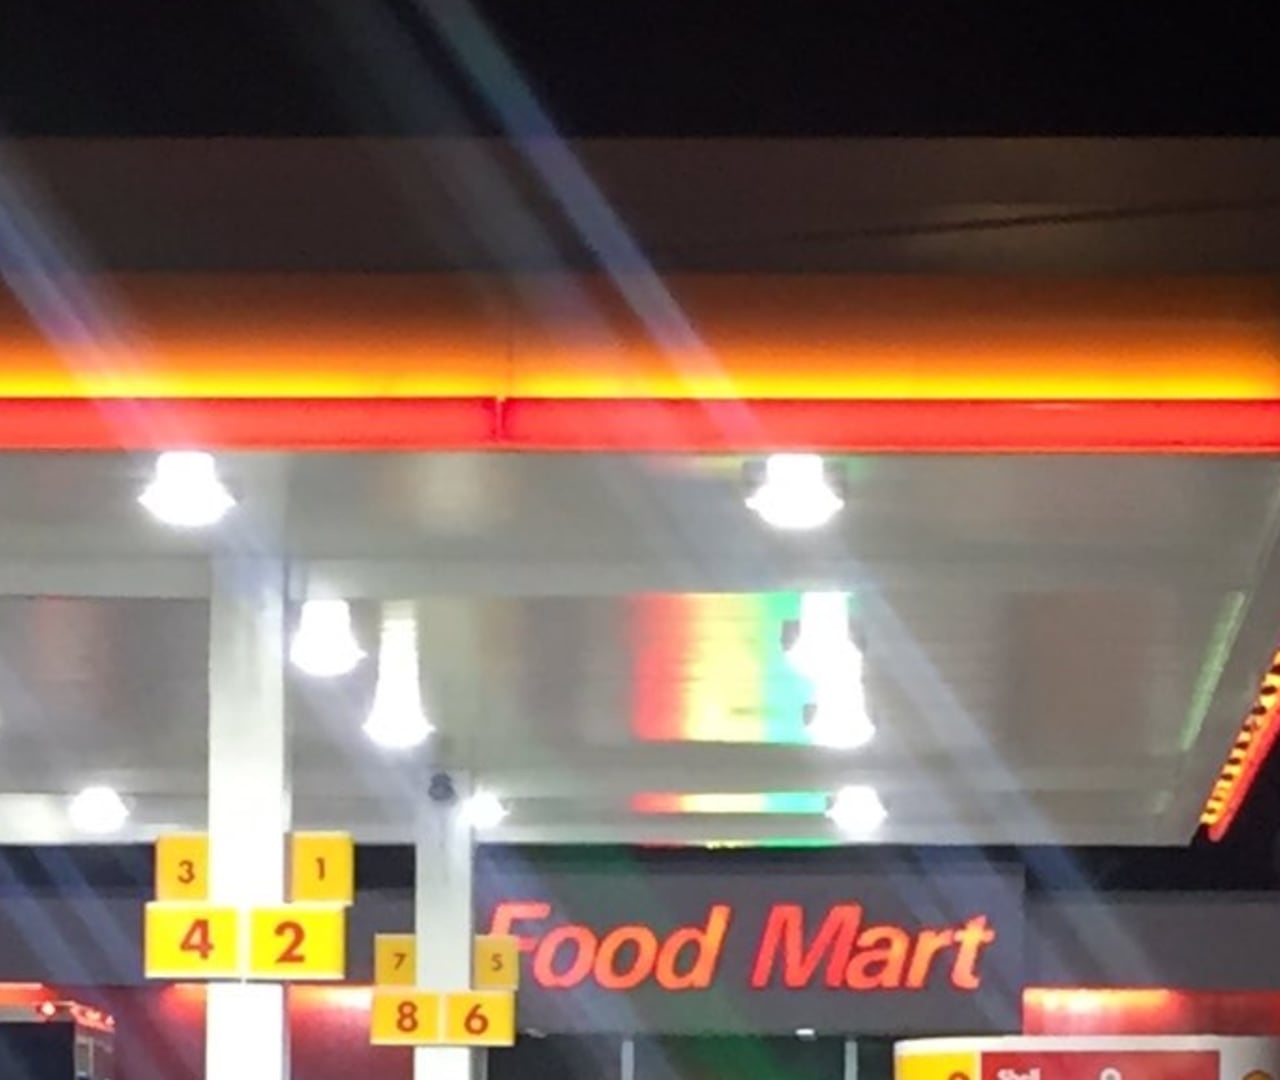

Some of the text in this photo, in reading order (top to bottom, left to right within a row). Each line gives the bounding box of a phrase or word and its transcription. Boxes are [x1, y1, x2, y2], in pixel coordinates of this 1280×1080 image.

[177, 859, 197, 884] 3
[314, 857, 326, 881] 1
[179, 918, 215, 961] 4
[273, 920, 306, 964] 2
[487, 901, 996, 990] Food Mart
[392, 952, 407, 972] 7
[490, 953, 504, 971] 5
[395, 1001, 419, 1033] 8
[463, 1003, 489, 1036] 6
